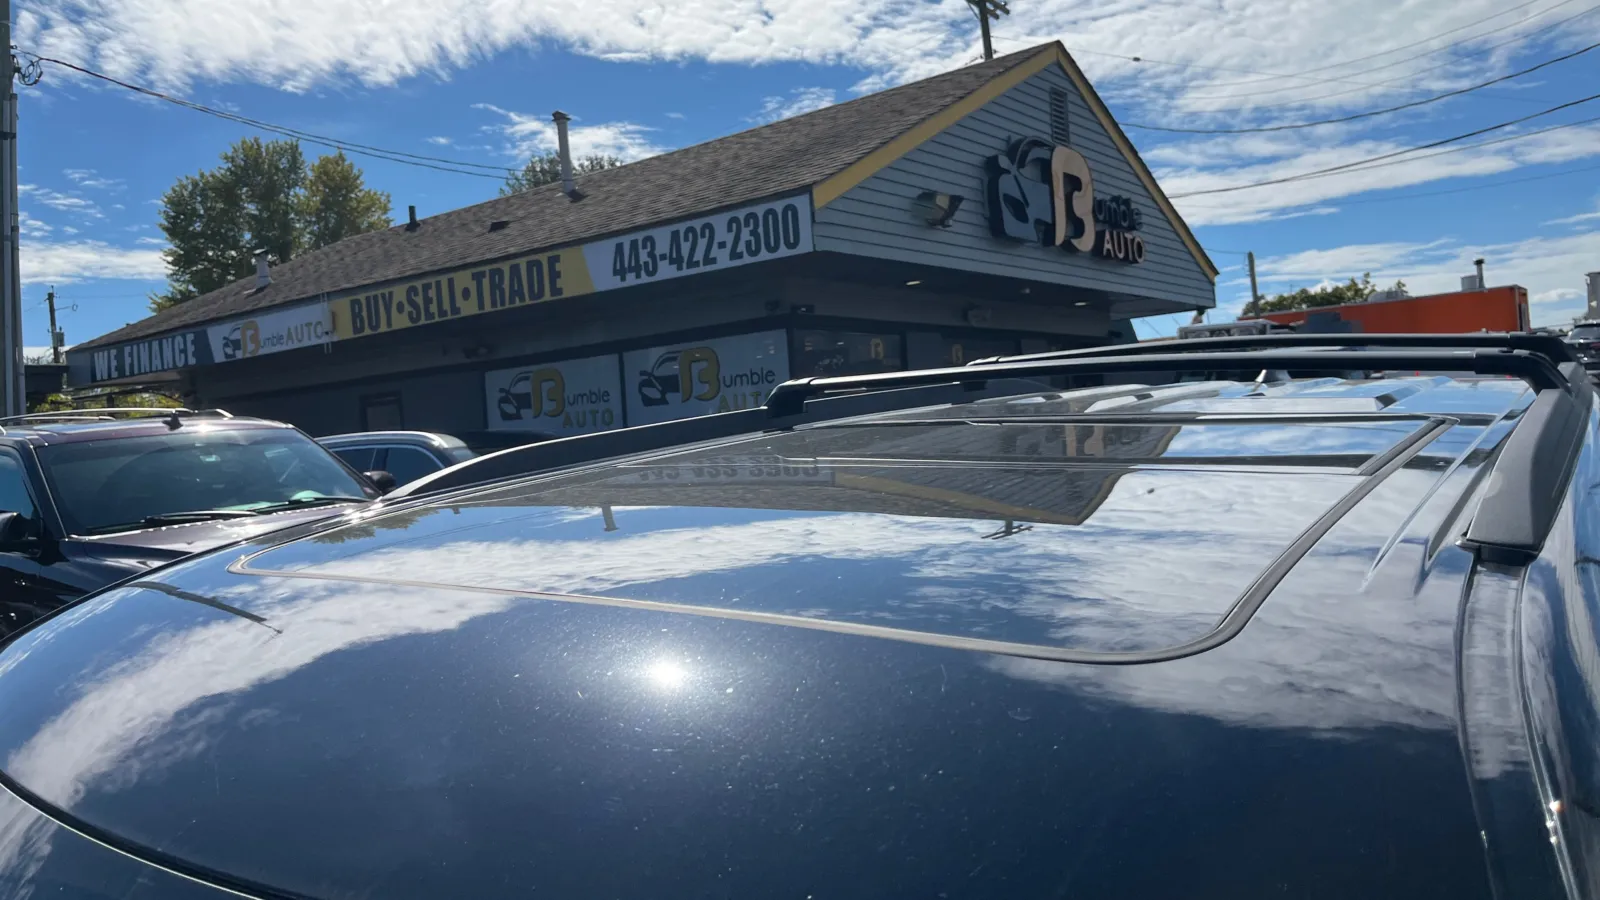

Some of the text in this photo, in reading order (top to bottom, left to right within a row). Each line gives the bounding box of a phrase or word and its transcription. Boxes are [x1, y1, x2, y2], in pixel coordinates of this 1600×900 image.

[612, 203, 801, 283] 443-422-2300
[1102, 229, 1145, 264] AUTO
[349, 254, 564, 336] BUY SELL TRADE
[285, 320, 325, 346] AUTO
[93, 332, 197, 381] WE FINANCE
[562, 407, 615, 429] AUTO
[718, 389, 773, 413] AUT
